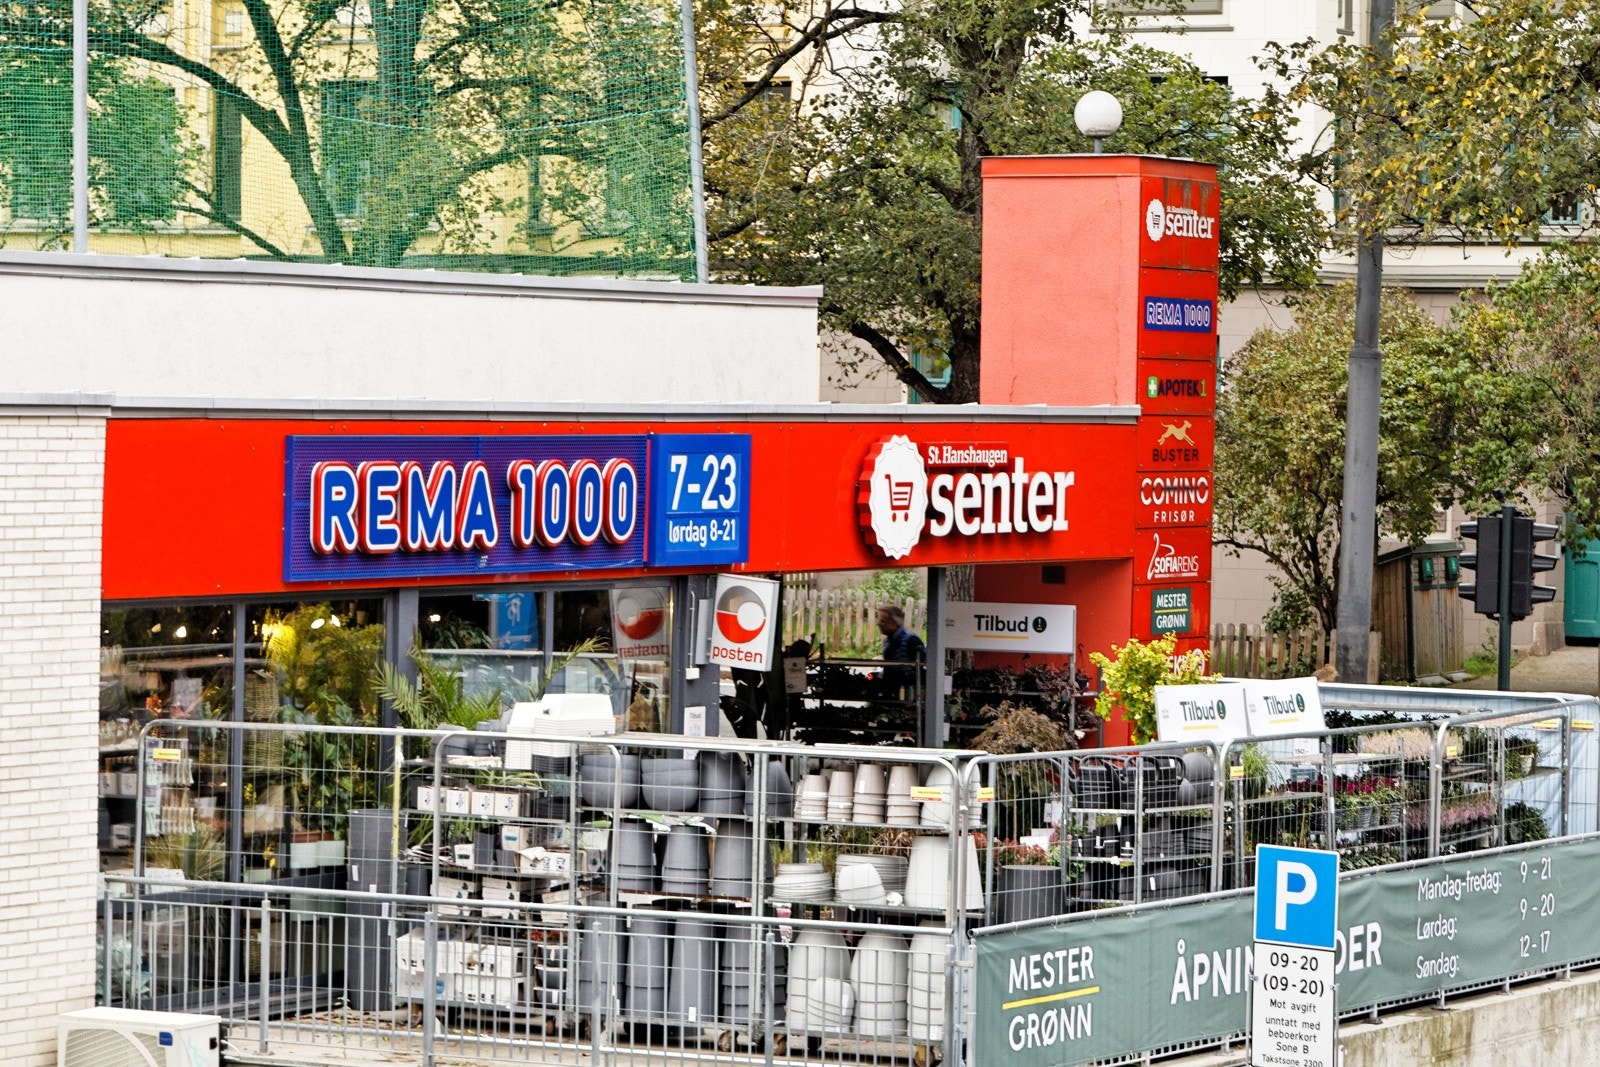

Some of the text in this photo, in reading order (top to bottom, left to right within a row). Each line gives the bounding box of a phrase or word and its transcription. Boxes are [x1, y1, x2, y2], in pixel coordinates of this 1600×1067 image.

[1166, 210, 1214, 239] senter
[1146, 302, 1210, 327] REMA 1000
[928, 445, 1008, 467] St. Hanshaugen
[1152, 448, 1199, 462] BUSTER
[670, 454, 737, 510] 7-23
[1140, 476, 1209, 506] COMINO
[310, 457, 638, 555] REMA 1000
[930, 457, 1075, 537] senter
[1154, 510, 1195, 522] FRISØR
[669, 518, 736, 548] lørdag 8-21
[1154, 555, 1198, 574] SOFIARENS
[1156, 593, 1187, 608] MESTER
[974, 614, 1028, 632] Tilbud
[1156, 614, 1186, 629] GRØNN
[712, 645, 763, 664] posten
[1180, 700, 1216, 722] Tilbud
[1263, 694, 1296, 715] Tilbud
[1417, 868, 1502, 901] Mandag-fredag:
[1520, 861, 1528, 883] 9
[1540, 856, 1552, 880] 21
[1275, 860, 1318, 931] P
[1416, 914, 1458, 940] Lørdag:
[1520, 898, 1528, 921] 9
[1540, 892, 1554, 916] 20
[1416, 952, 1460, 980] Søndag:
[1520, 934, 1530, 958] 12
[1540, 930, 1550, 954] 17
[1008, 946, 1095, 994] MESTER
[1269, 998, 1316, 1014] Mot avgift
[1008, 1002, 1092, 1051] GRØNN
[1265, 1016, 1320, 1031] unntatt med
[1268, 1028, 1317, 1043] beboerkort
[1276, 1042, 1309, 1054] Sone B
[1262, 1054, 1300, 1066] Takstsone
